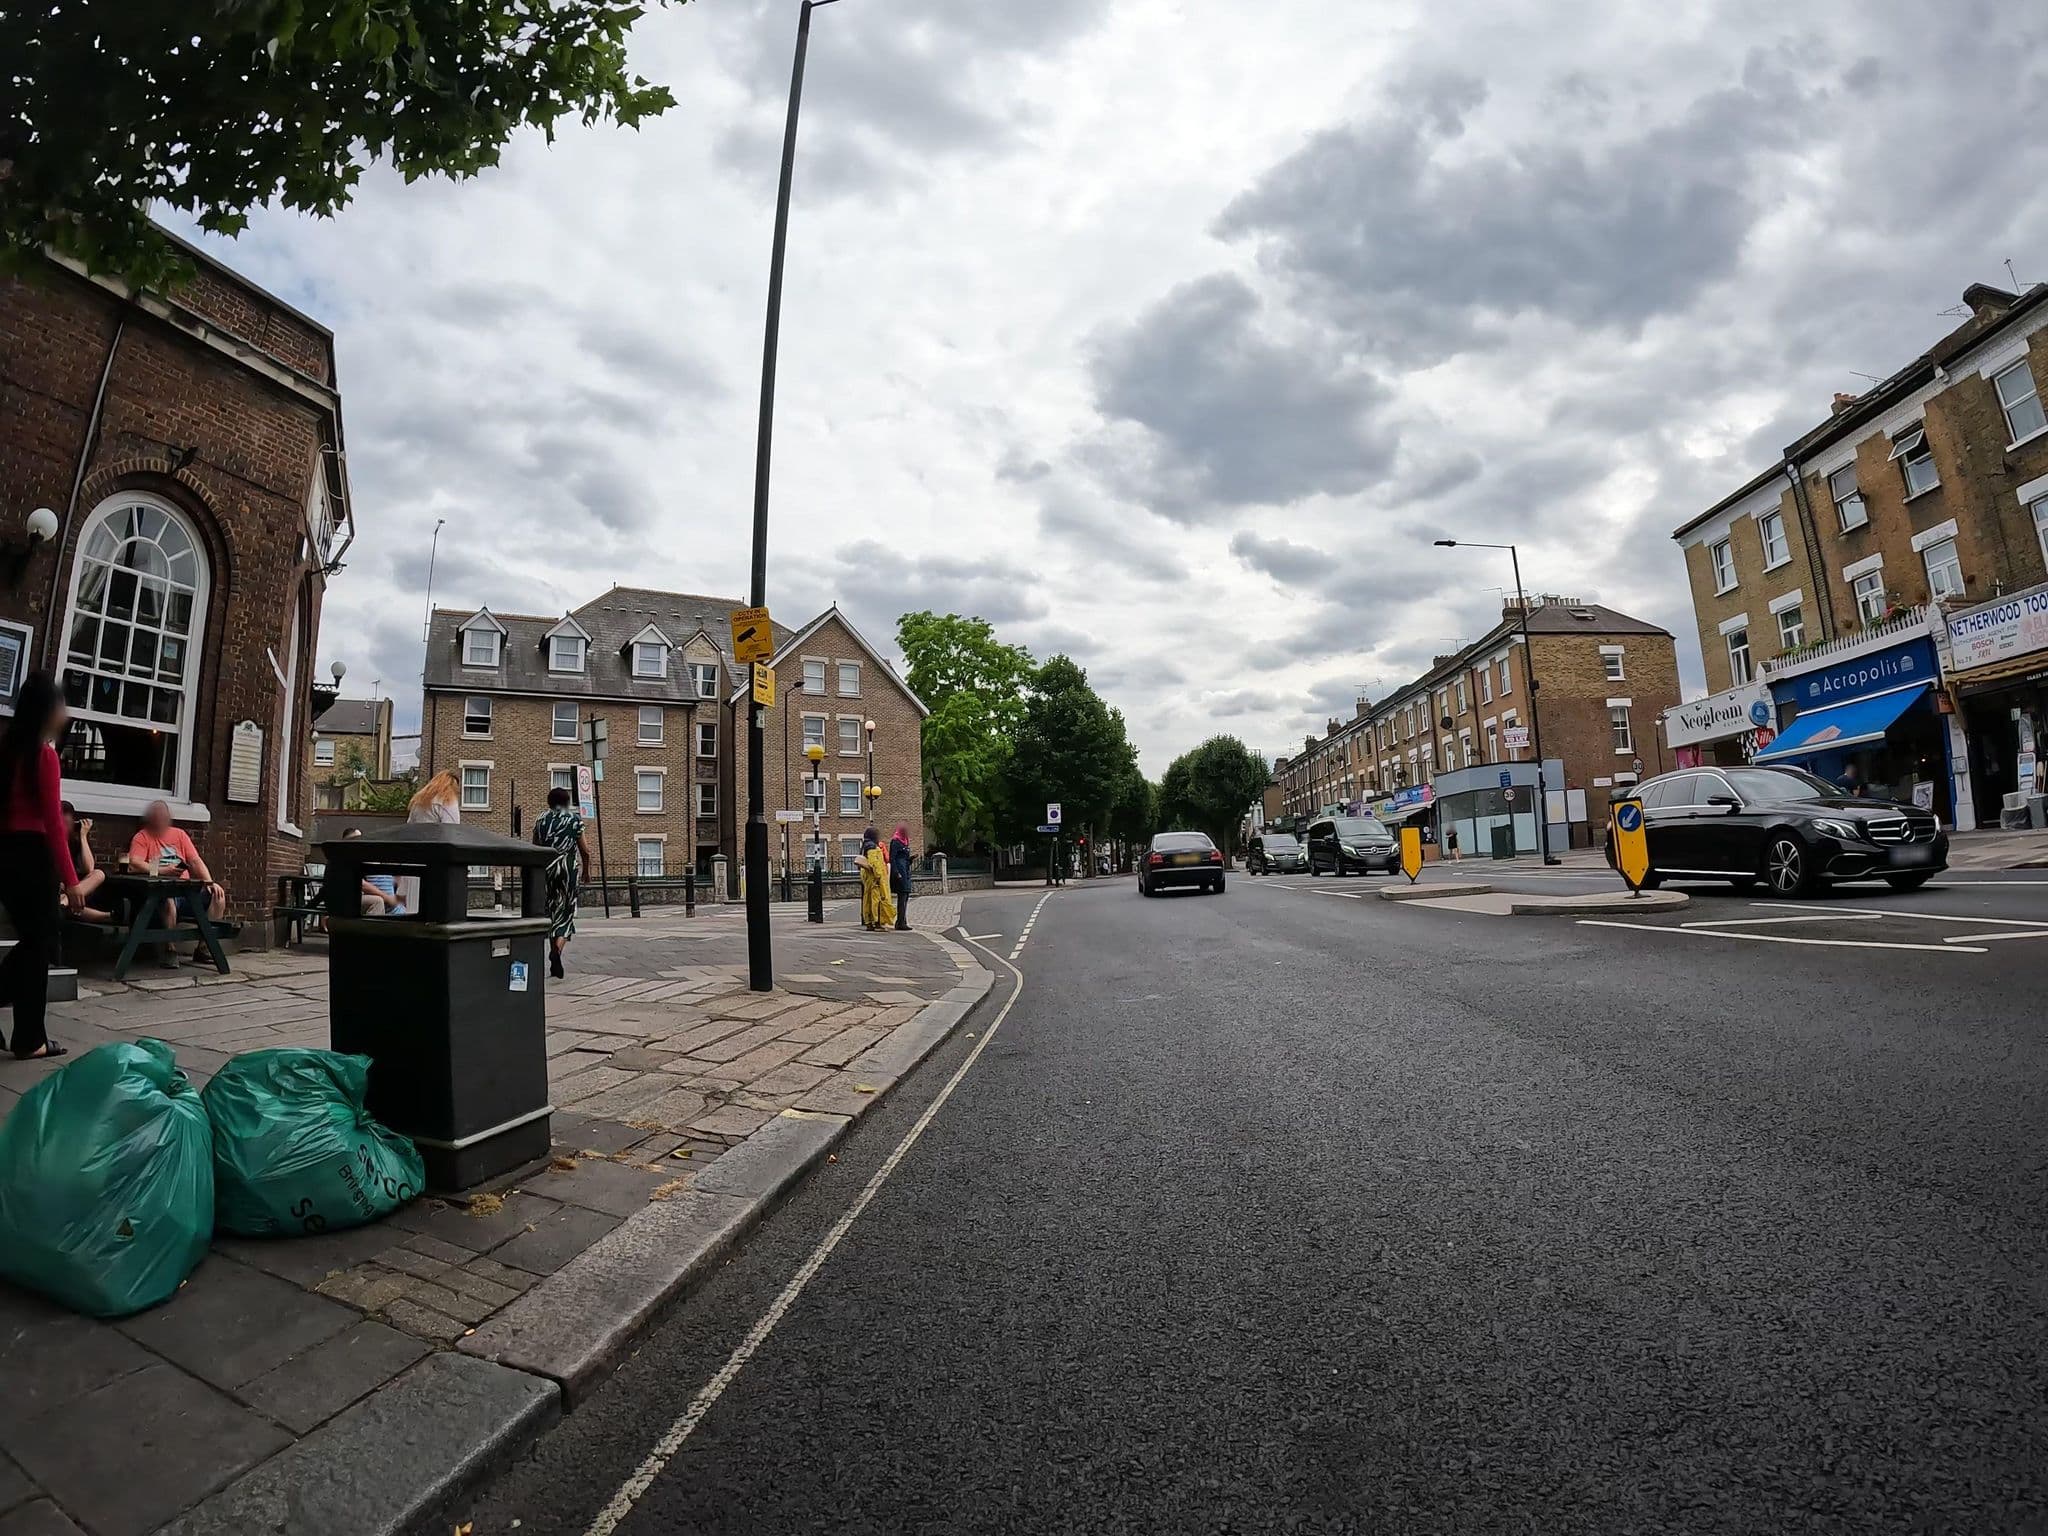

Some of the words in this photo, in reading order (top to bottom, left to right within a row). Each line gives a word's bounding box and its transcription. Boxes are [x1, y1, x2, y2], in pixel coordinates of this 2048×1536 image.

[733, 613, 767, 622] OPERATION
[737, 609, 755, 618] CCTV
[1949, 602, 2021, 638] NETHERWOOD
[2024, 592, 2048, 615] TOO
[1971, 637, 1995, 650] BOSCH
[1824, 660, 1897, 693] Acropolis
[1680, 704, 1743, 731] Neogleam
[1633, 762, 1643, 770] 30
